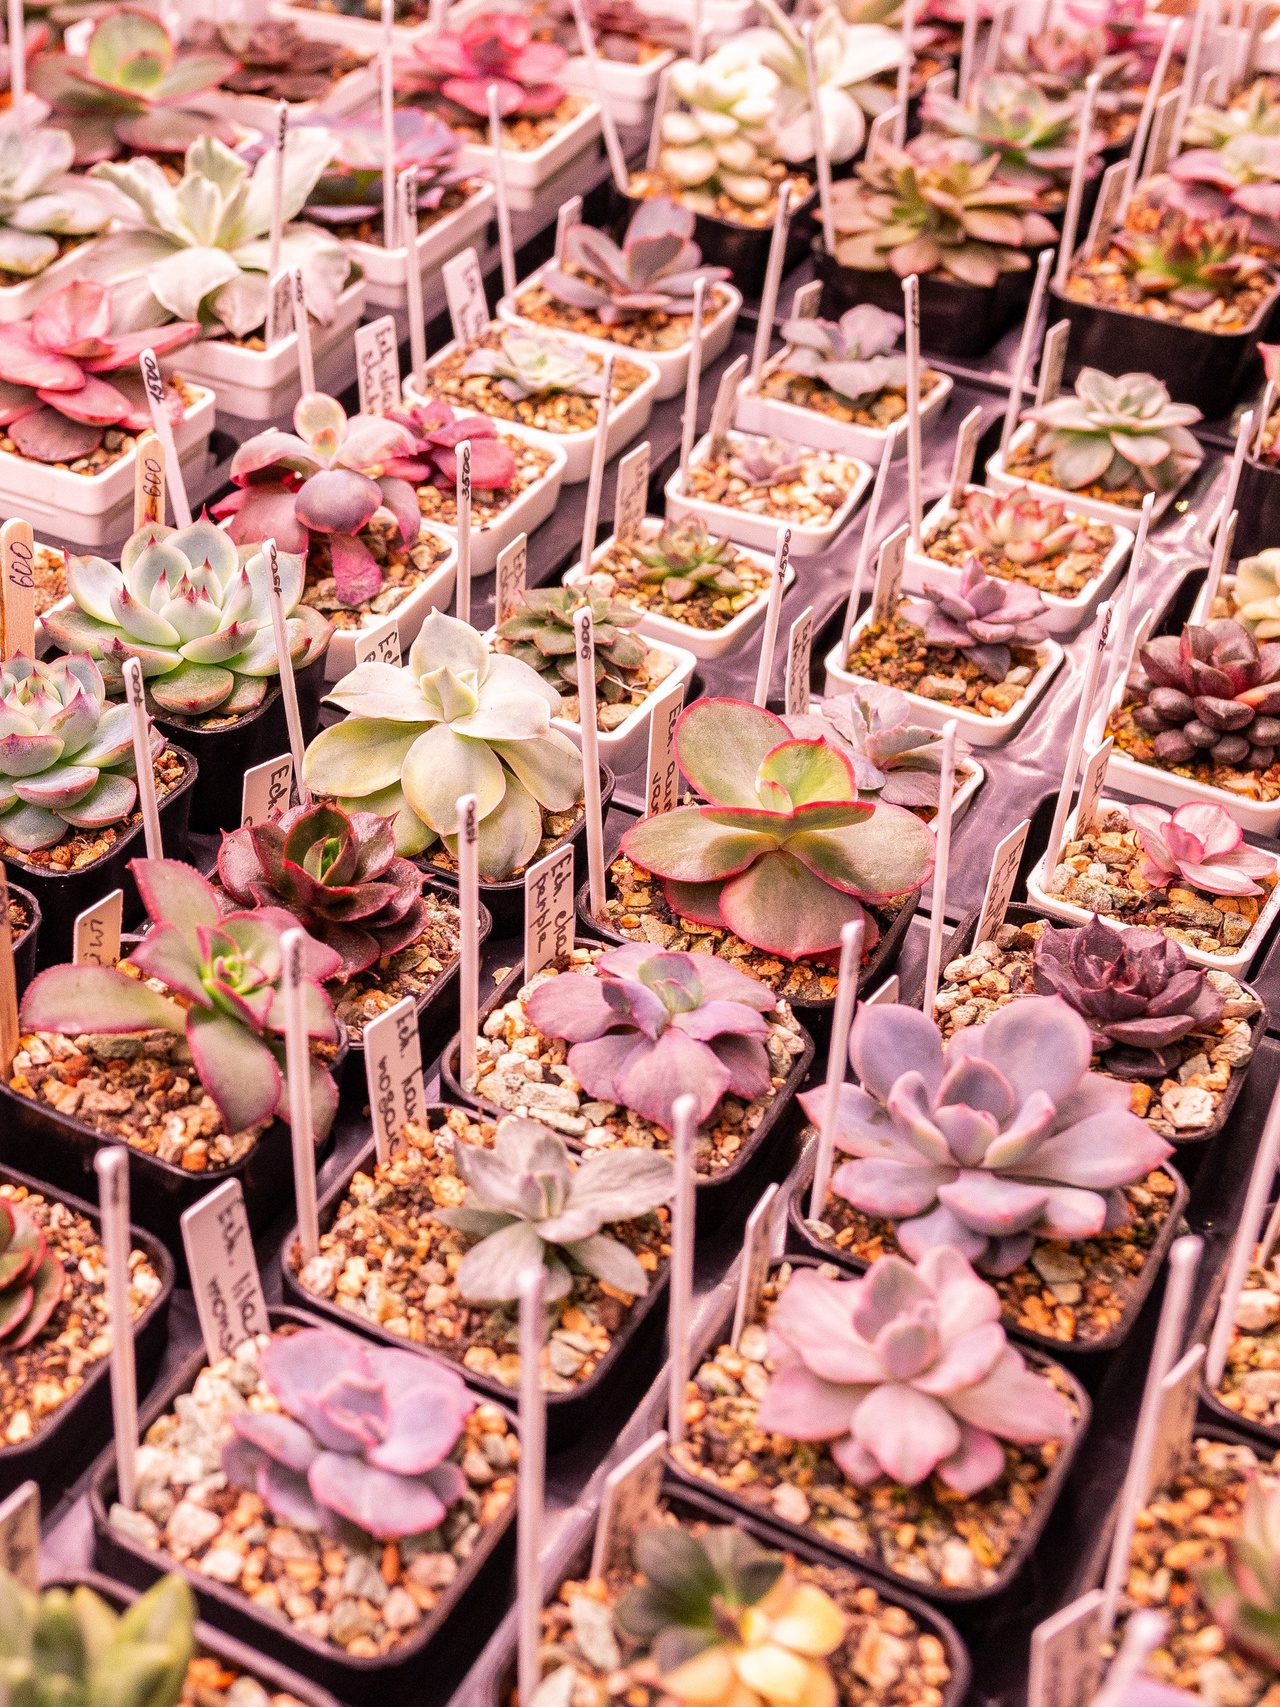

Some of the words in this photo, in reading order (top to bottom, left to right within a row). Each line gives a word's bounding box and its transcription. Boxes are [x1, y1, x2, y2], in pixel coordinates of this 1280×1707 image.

[144, 356, 165, 404] 1500
[142, 458, 162, 498] 600
[461, 447, 471, 501] 3500
[9, 541, 35, 589] 600
[270, 545, 283, 598] 1500
[778, 528, 792, 584] 1500
[581, 616, 591, 661] 900
[549, 852, 572, 903] Ech.
